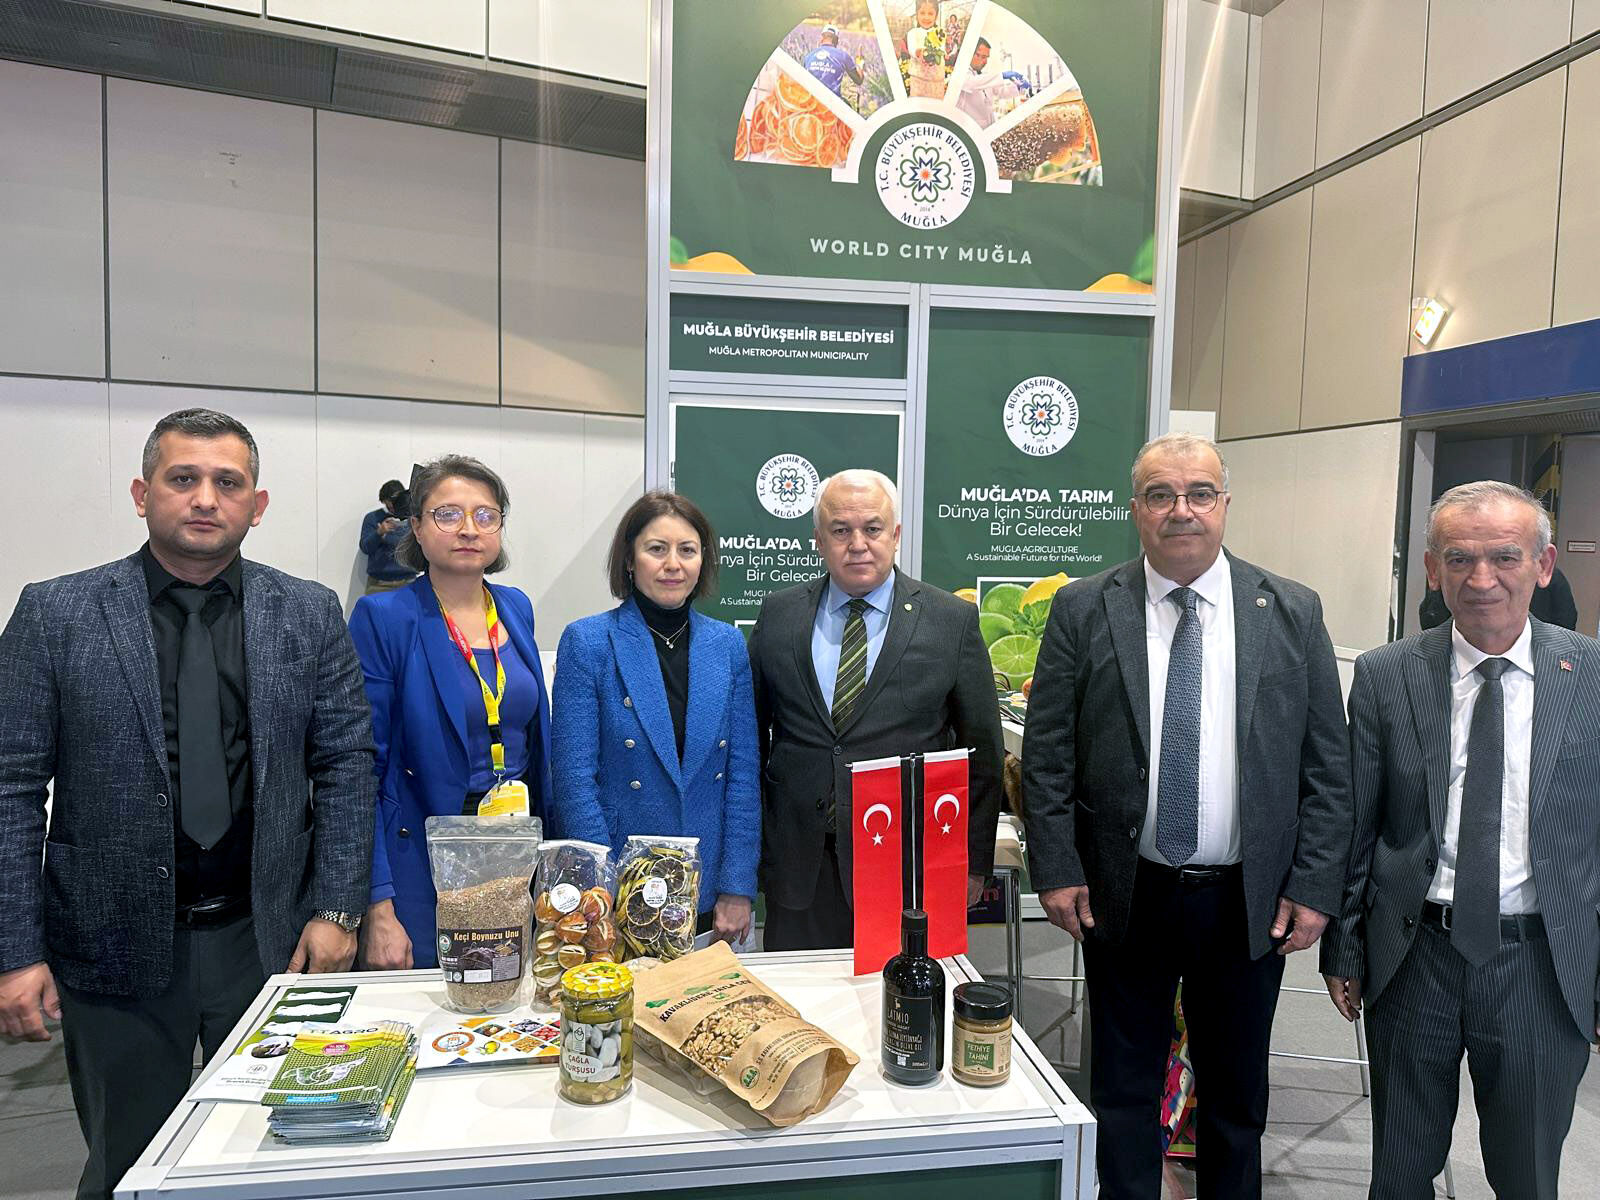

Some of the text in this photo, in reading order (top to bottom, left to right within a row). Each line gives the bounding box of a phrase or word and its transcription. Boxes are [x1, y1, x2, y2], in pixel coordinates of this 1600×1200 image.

[879, 126, 973, 198] T.C. BÜYÜKŞEHİR BELEDİYESİ
[901, 212, 948, 227] MUĞLA
[810, 238, 1032, 264] WORLD CITY MUĞLA
[683, 322, 894, 344] MUĞLA BÜYÜKŞEHİR BELEDİYESİ
[709, 345, 869, 361] MUĞLA METROPOLITAN MUNICIPALITY
[1022, 443, 1058, 454] MUĞLA
[1059, 489, 1113, 504] TARIM
[773, 508, 802, 517] MUĞLA
[938, 503, 1131, 522] Dünya İçin Sürdürülebilir
[990, 522, 1082, 537] Bir Gelecek!
[1022, 545, 1078, 554] AGRICULTURE
[720, 551, 825, 568] nya İçin Sürdür
[966, 553, 1103, 562] A Sustainable Future for the World!
[746, 569, 766, 581] Bir
[454, 930, 519, 943] Keçi Boynuzu Unu
[568, 1054, 590, 1065] ÇAĞLA
[565, 1062, 596, 1074] TURŞUSU
